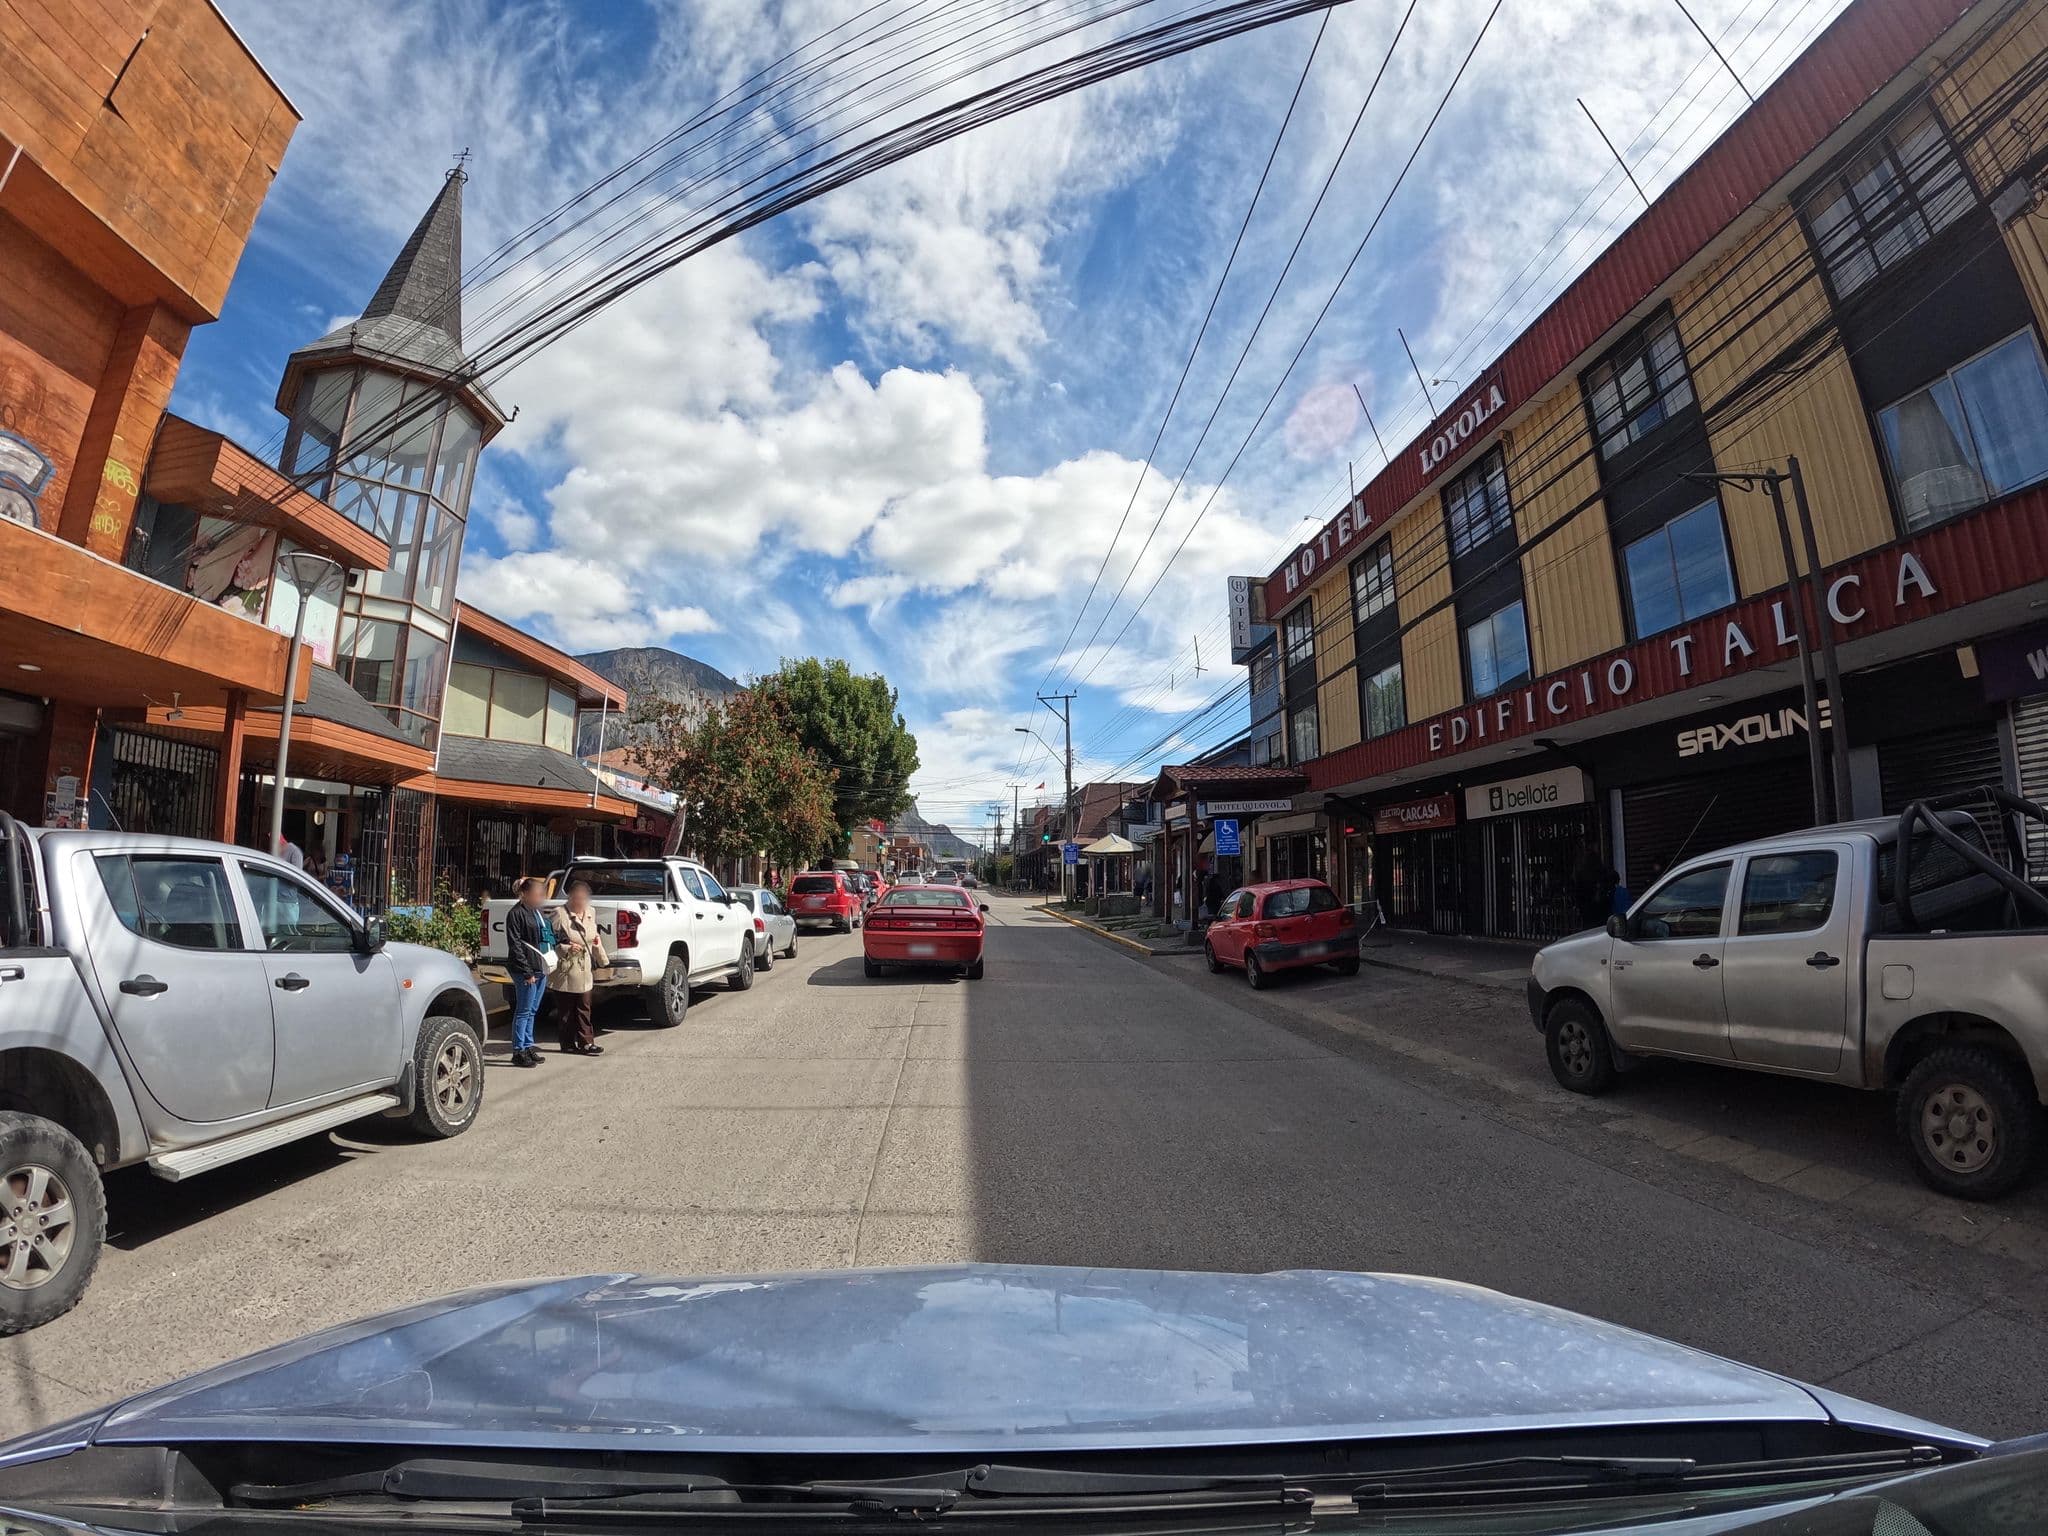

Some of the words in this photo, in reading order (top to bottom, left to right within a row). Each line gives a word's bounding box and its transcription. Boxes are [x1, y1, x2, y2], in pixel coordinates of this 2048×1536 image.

[1285, 499, 1372, 593] HOTEL
[1420, 385, 1506, 475] LOYOLA
[1232, 579, 1247, 645] HOTEL
[1429, 659, 1633, 751] EDIFICIO
[1670, 552, 1937, 677] TALCA
[1214, 803, 1241, 812] HOTEL
[1254, 802, 1287, 810] LOYOLA
[1380, 807, 1401, 818] ELECTRO
[1400, 803, 1441, 822] CARCASA
[1507, 783, 1558, 808] bellota
